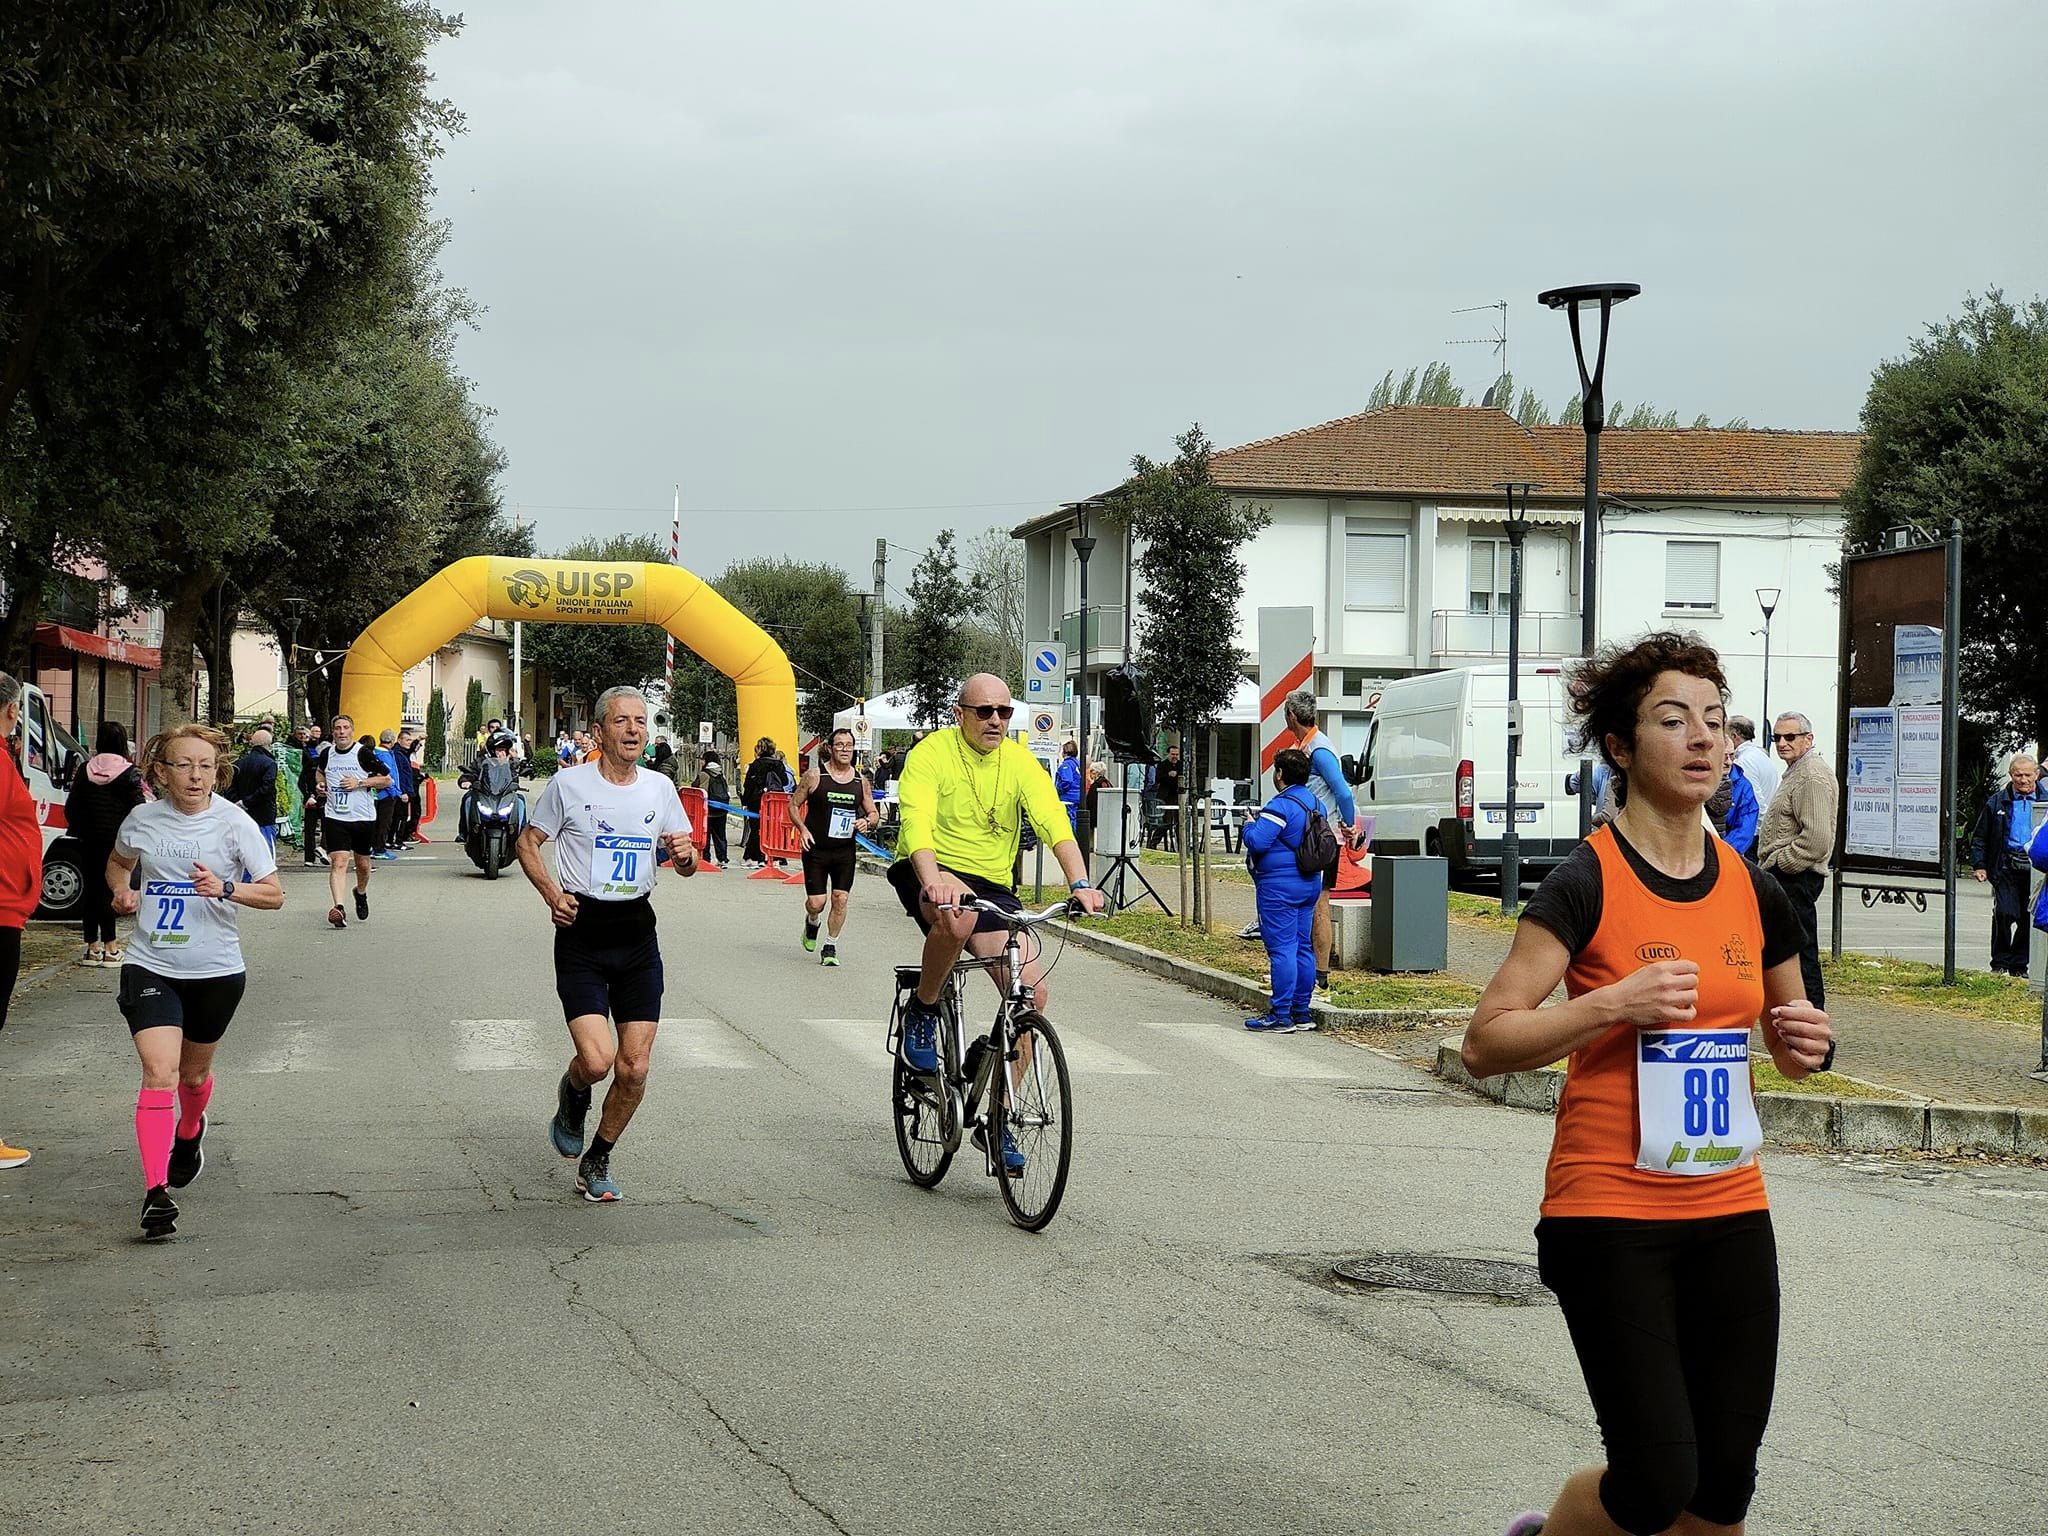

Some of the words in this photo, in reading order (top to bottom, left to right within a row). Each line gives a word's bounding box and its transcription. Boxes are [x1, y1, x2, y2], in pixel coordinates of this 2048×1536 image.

[557, 571, 633, 597] UISP
[556, 598, 590, 607] UNIONE
[594, 599, 633, 608] ITALIANA
[556, 606, 583, 614] SPORT
[1897, 656, 1915, 675] Ivan
[1918, 653, 1941, 674] Alvisi
[1902, 732, 1918, 741] NARDI
[1919, 732, 1940, 741] NATALIA
[1854, 786, 1891, 795] RINGRAZIAMENTO
[1900, 787, 1937, 795] RINGRAZIAMENTO
[336, 793, 348, 804] 127
[1853, 800, 1874, 812] ALVISI
[1875, 801, 1890, 813] IVAN
[1898, 804, 1915, 814] TURCHI
[1916, 804, 1938, 814] ANSELMO
[155, 849, 200, 859] MAMELI
[612, 851, 637, 881] 20
[162, 883, 198, 895] Mizun
[157, 898, 184, 930] 22
[1641, 947, 1676, 959] LUCCI
[1689, 1040, 1747, 1059] Mizuno
[1684, 1067, 1730, 1137] 88
